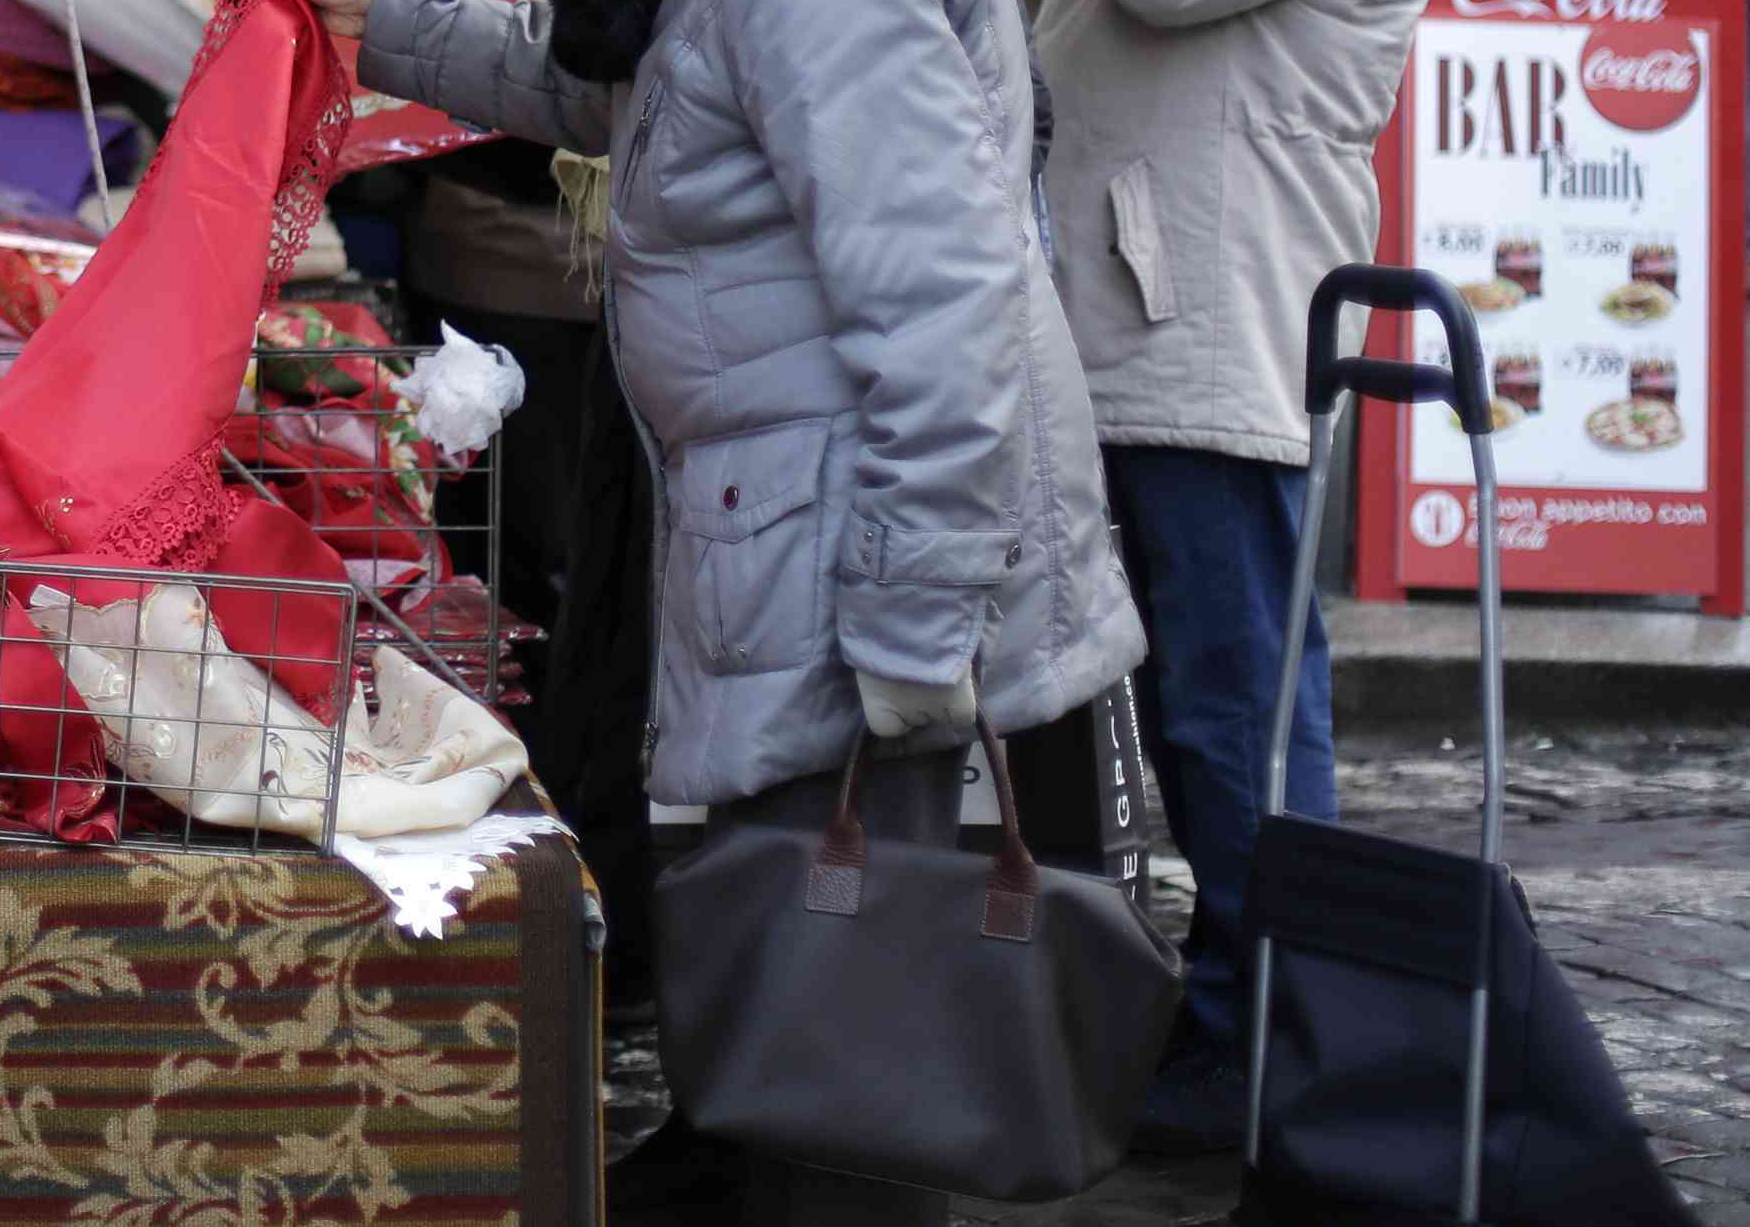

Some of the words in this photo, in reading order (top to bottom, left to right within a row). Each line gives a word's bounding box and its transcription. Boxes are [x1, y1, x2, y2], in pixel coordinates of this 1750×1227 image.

[1583, 45, 1700, 93] Coca-Cola
[1431, 55, 1576, 158] BAR
[1538, 144, 1646, 215] Family
[1655, 502, 1708, 525] con
